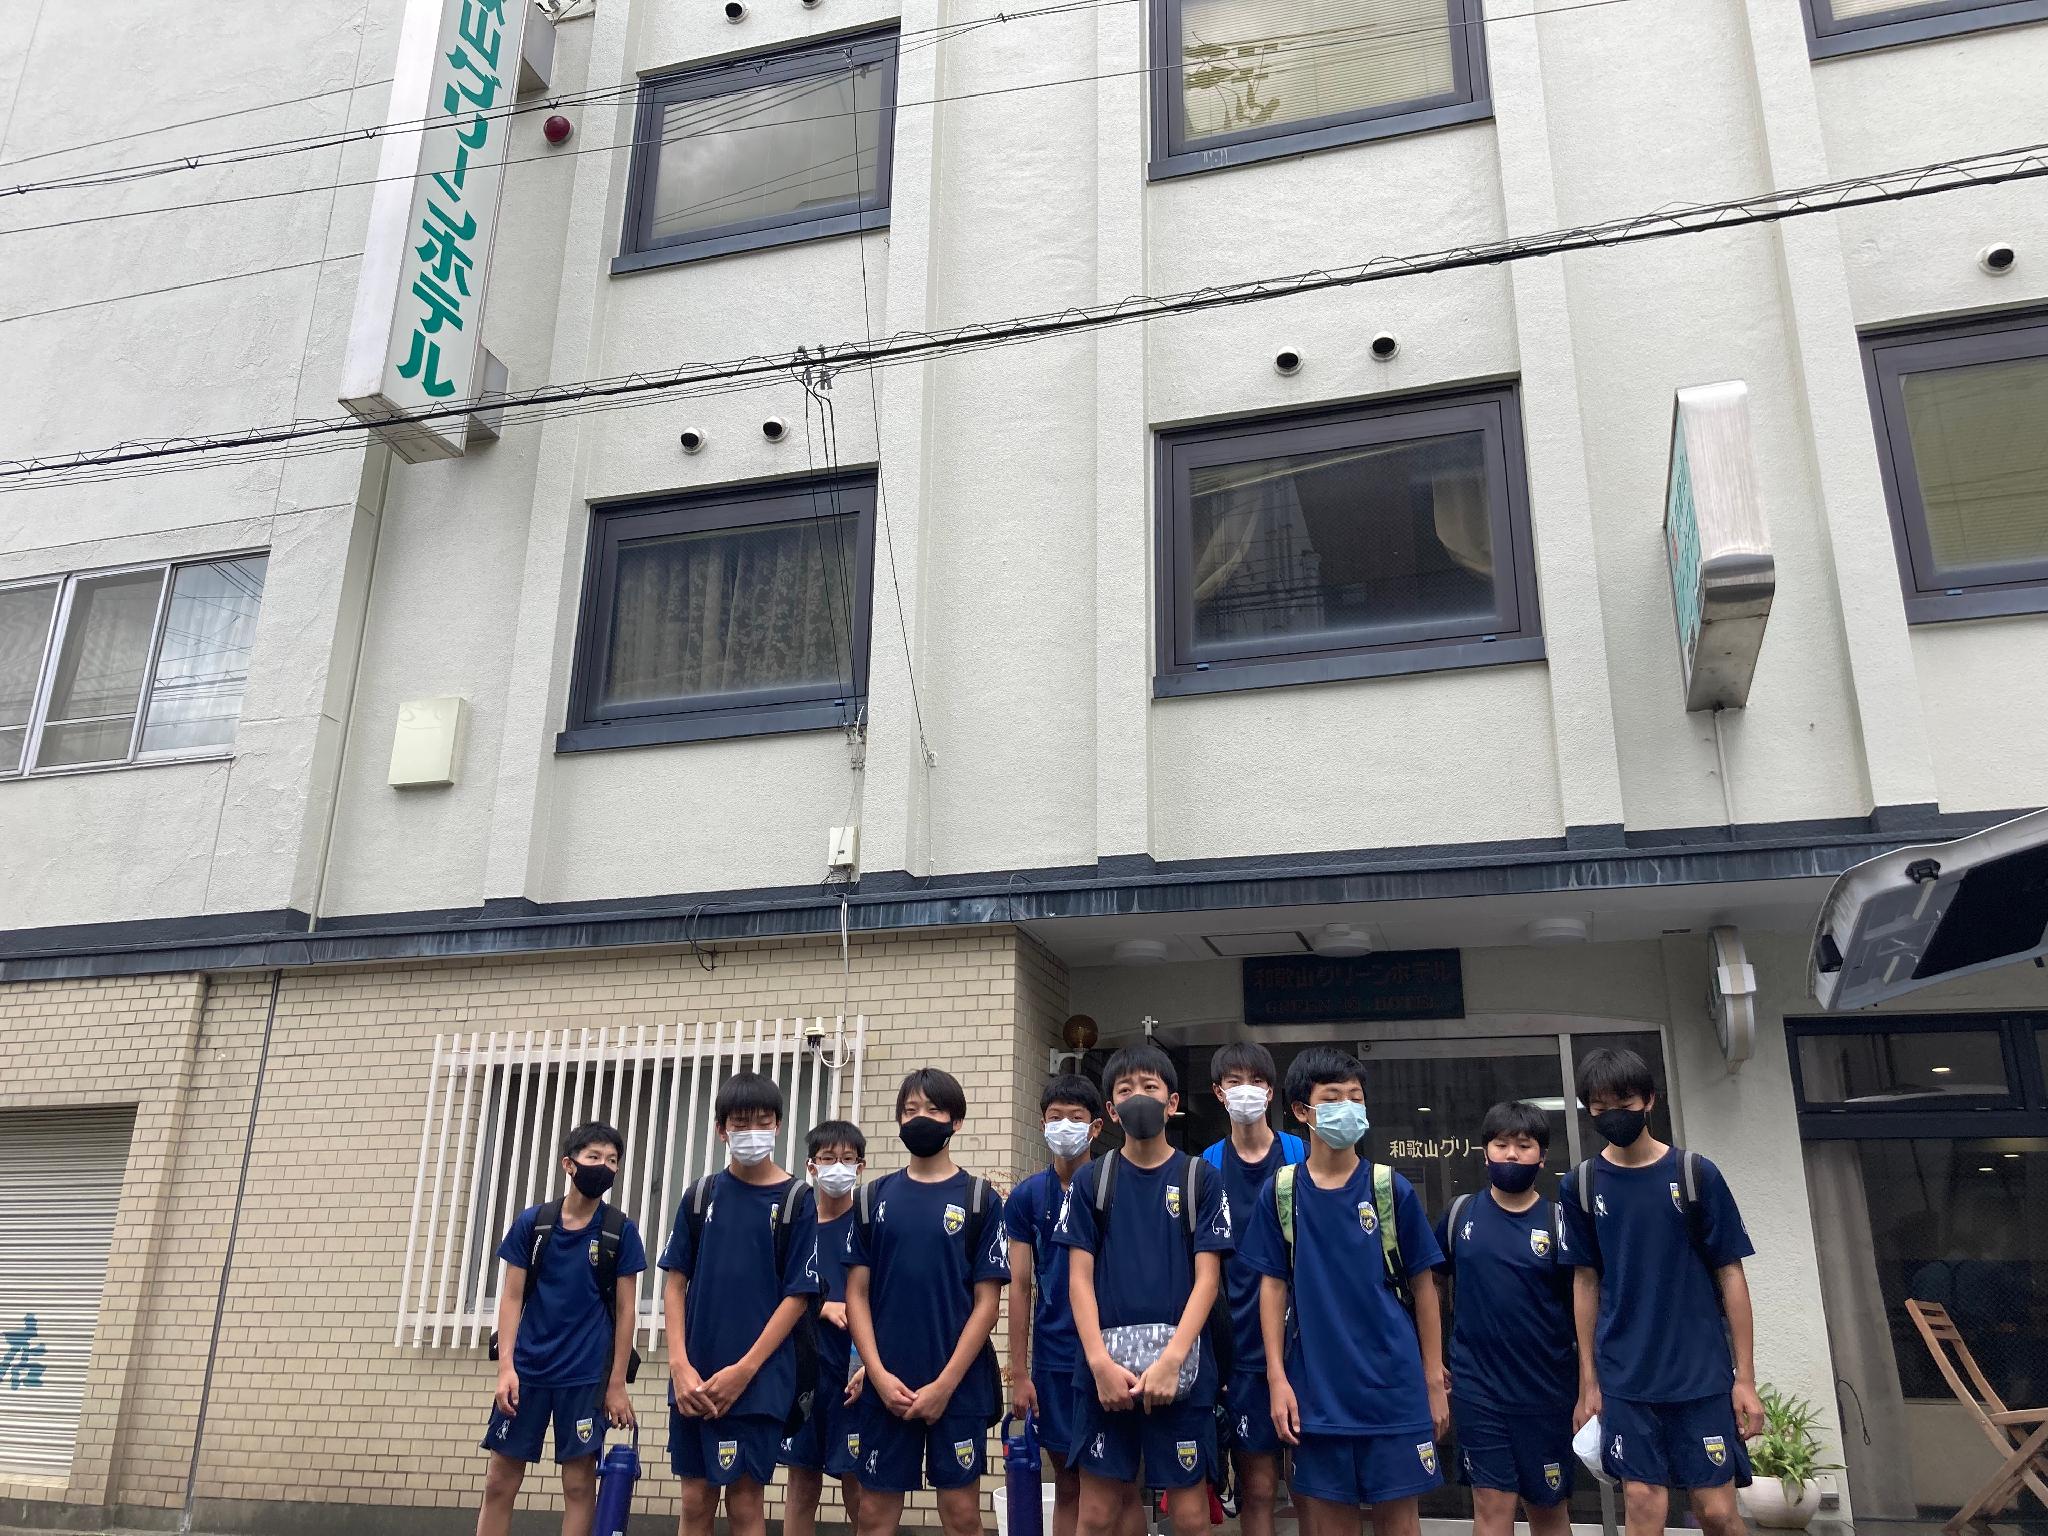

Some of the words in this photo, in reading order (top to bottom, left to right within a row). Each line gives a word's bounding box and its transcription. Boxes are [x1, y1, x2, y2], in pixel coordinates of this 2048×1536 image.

[396, 0, 507, 397] 山グリーンホテル
